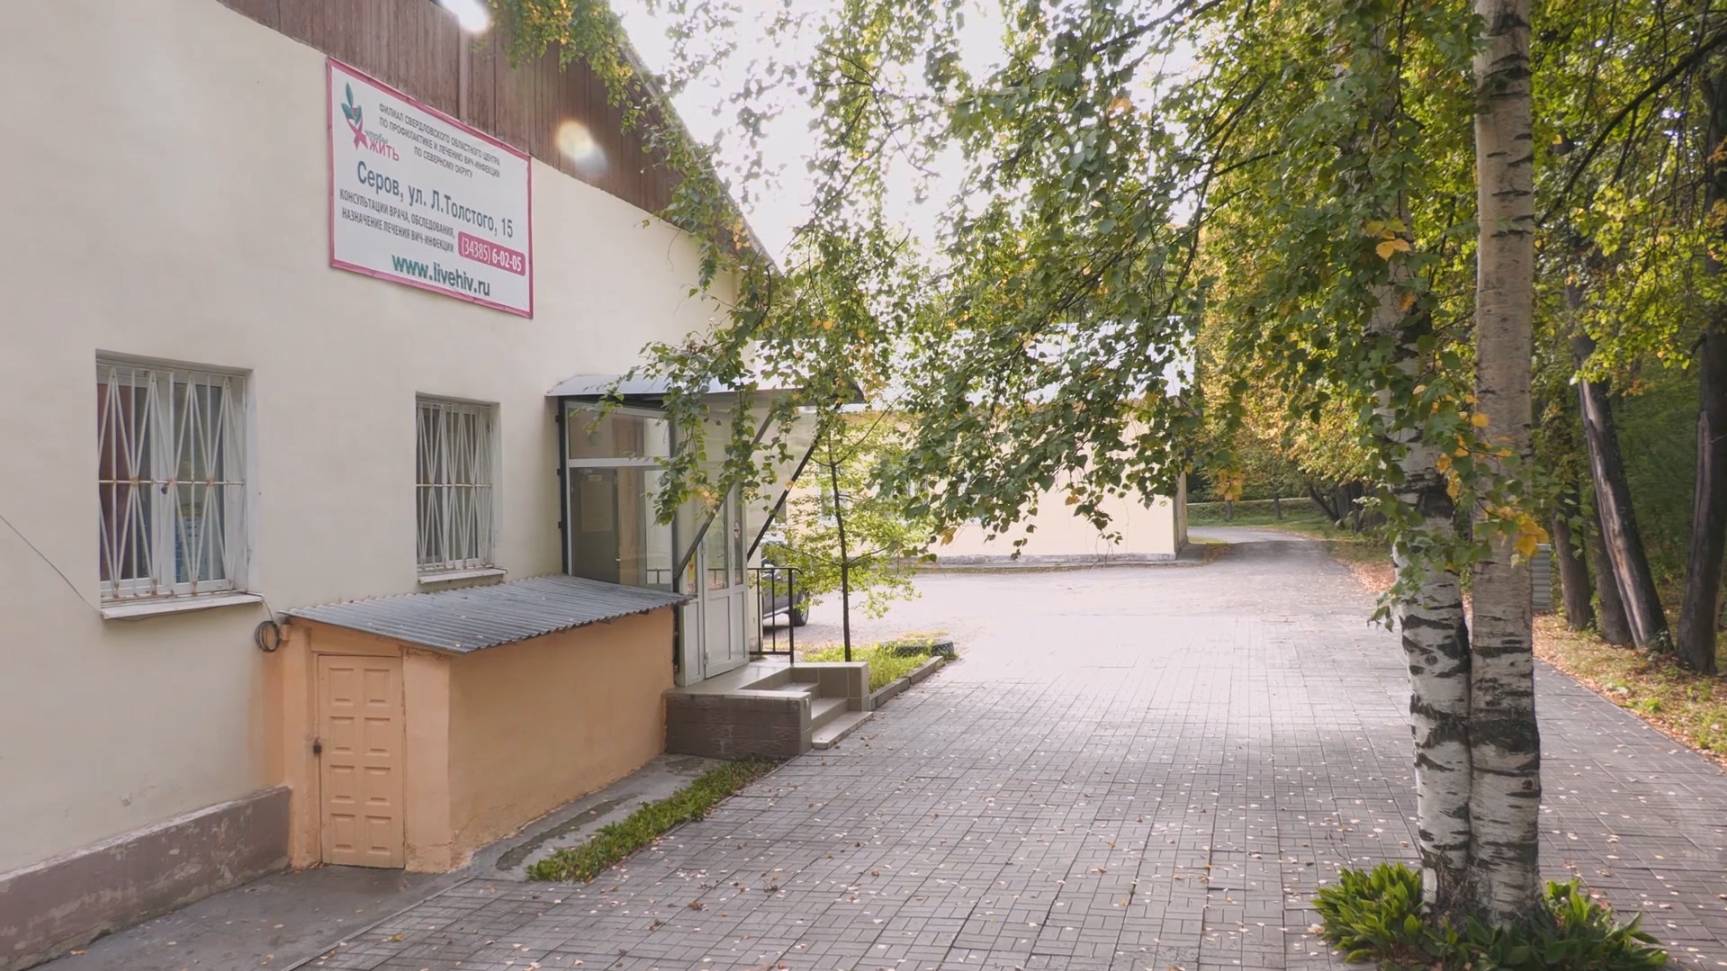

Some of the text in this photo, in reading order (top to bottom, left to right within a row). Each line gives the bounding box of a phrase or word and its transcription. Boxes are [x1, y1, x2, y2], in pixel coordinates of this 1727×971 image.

[379, 103, 403, 121] ФИЛИАЛ
[405, 115, 450, 143] СВЕРДЛОВСКОГО
[379, 116, 388, 128] ПО
[390, 120, 433, 149] ПРОФИЛАКТИКЕ
[439, 144, 463, 161] ЛЕЧЕНИЮ
[414, 145, 422, 158] ПО
[340, 189, 388, 215] КОНСУЛЬТАЦИИ
[357, 160, 513, 238] Серов, ул. Л.Толстого, 15
[342, 207, 382, 230] НАЗНАЧЕНИЕ
[462, 236, 522, 272] (34385) 6-02-05
[392, 255, 490, 296] www.livehiv.ru
